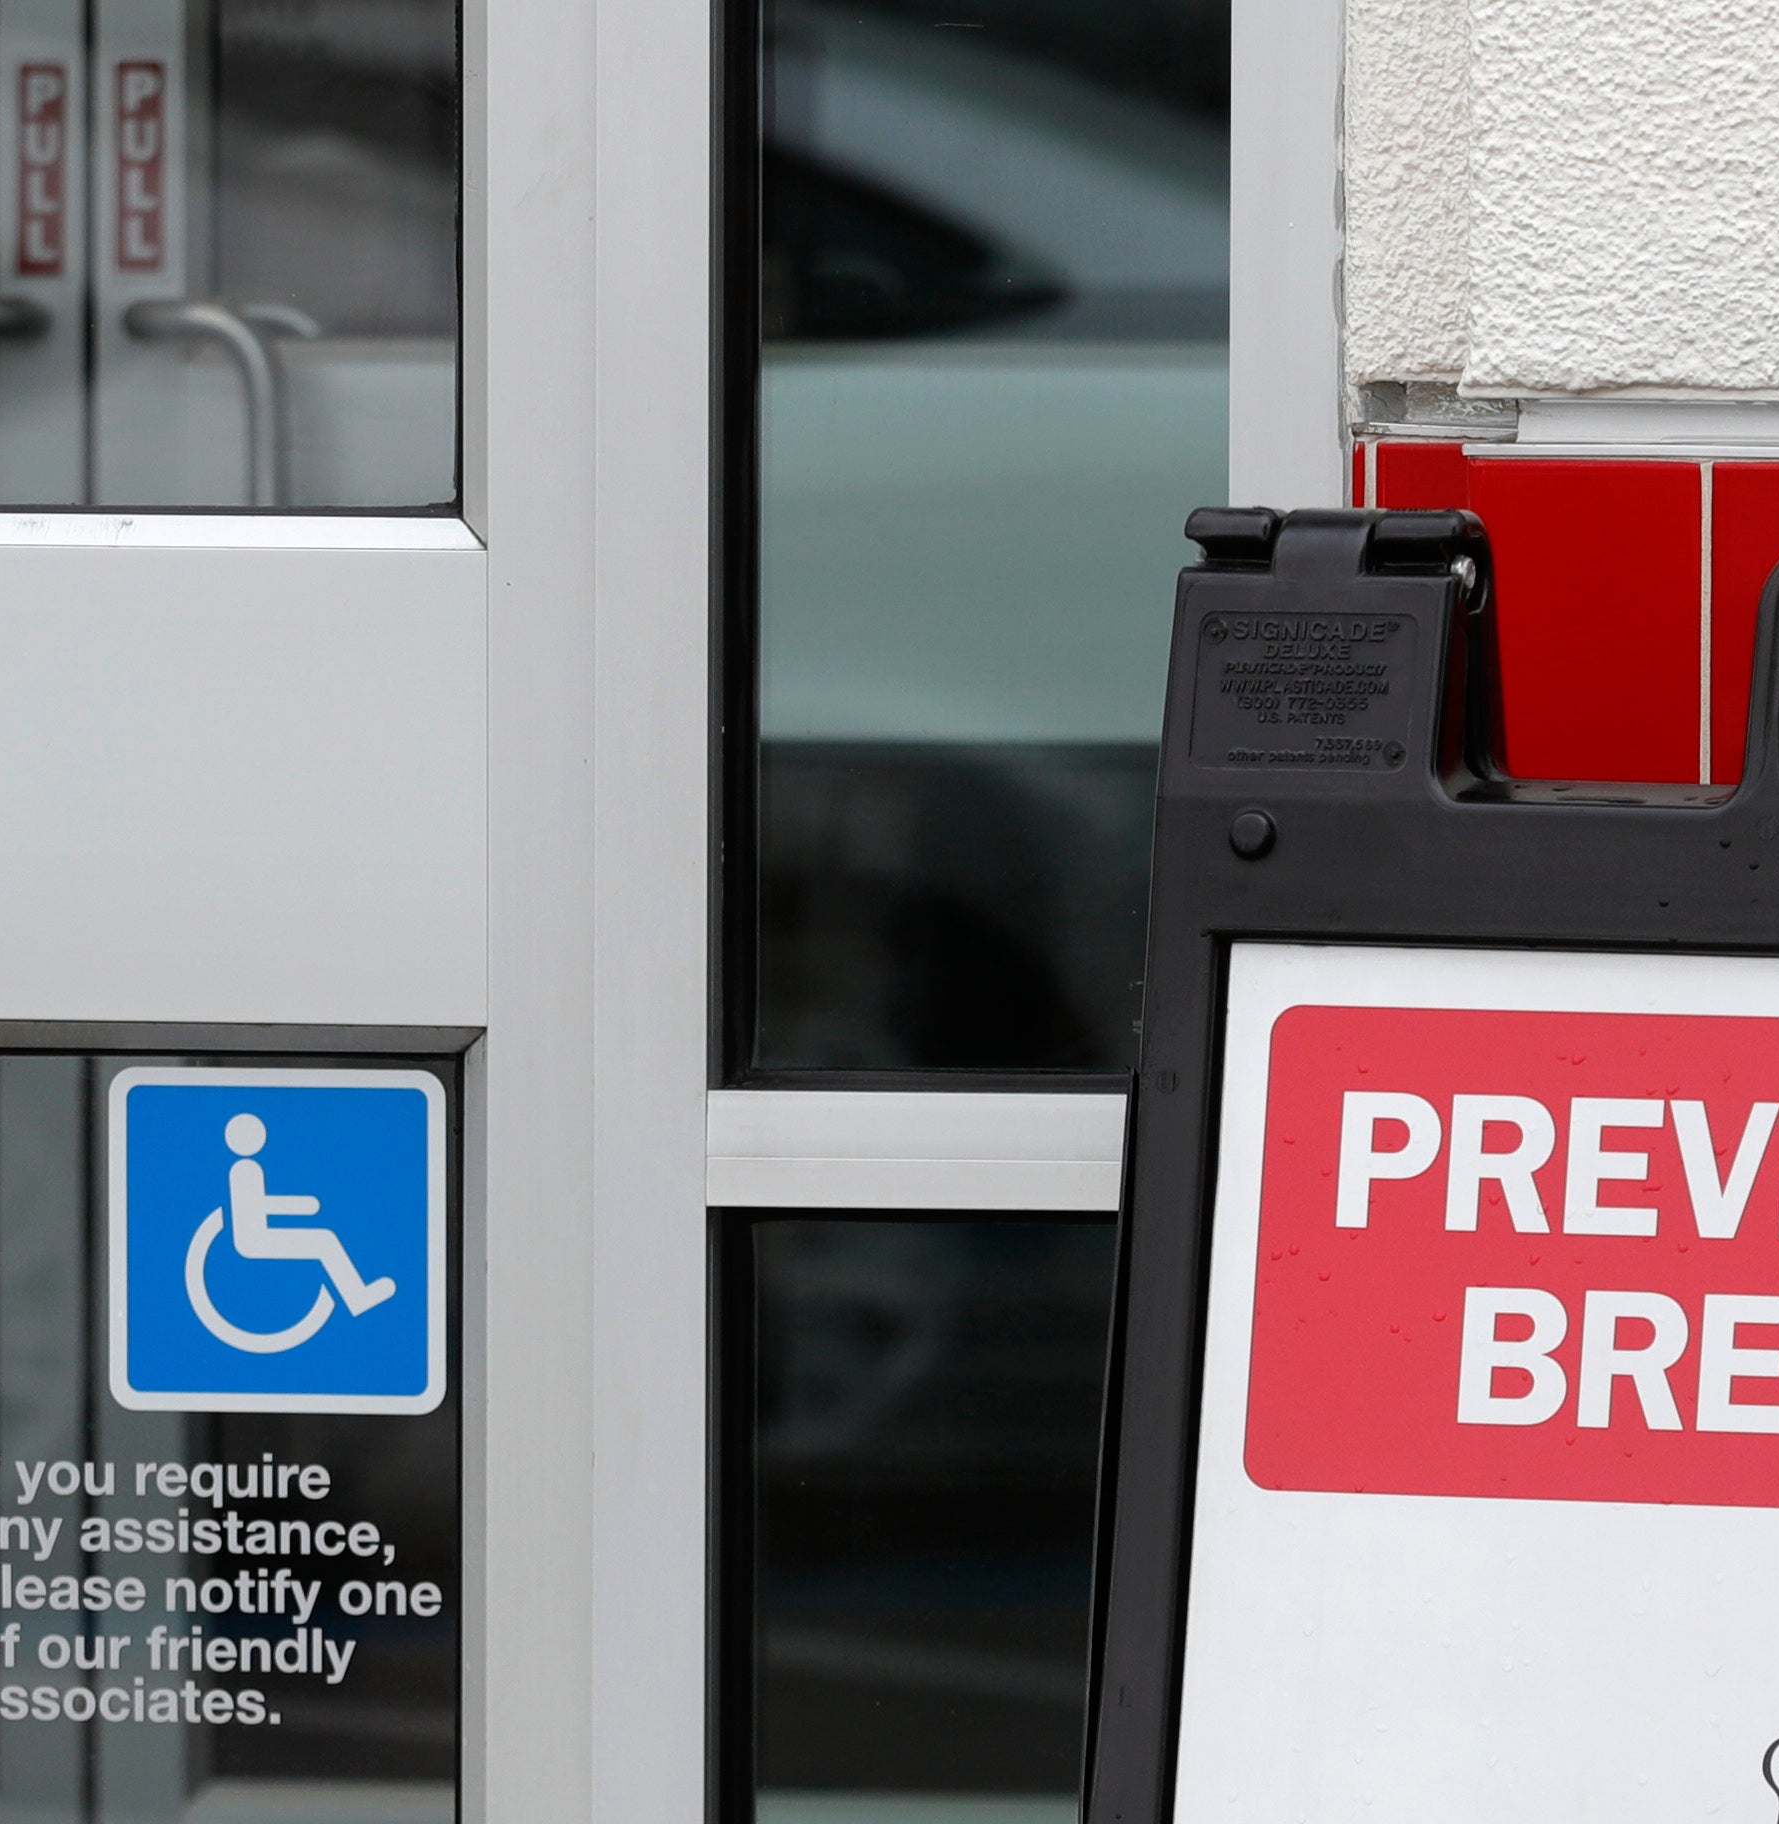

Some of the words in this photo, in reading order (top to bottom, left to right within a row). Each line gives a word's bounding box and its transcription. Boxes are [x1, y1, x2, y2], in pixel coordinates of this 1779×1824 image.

[24, 74, 62, 262] PULL
[123, 71, 160, 260] PULL
[1263, 642, 1352, 661] DELUXE
[15, 1459, 116, 1505] you
[134, 1452, 332, 1509] require
[80, 1508, 396, 1567] assistance,
[165, 1567, 321, 1625] notify
[338, 1580, 443, 1618] one
[37, 1632, 131, 1671] our
[146, 1625, 357, 1685] friendly
